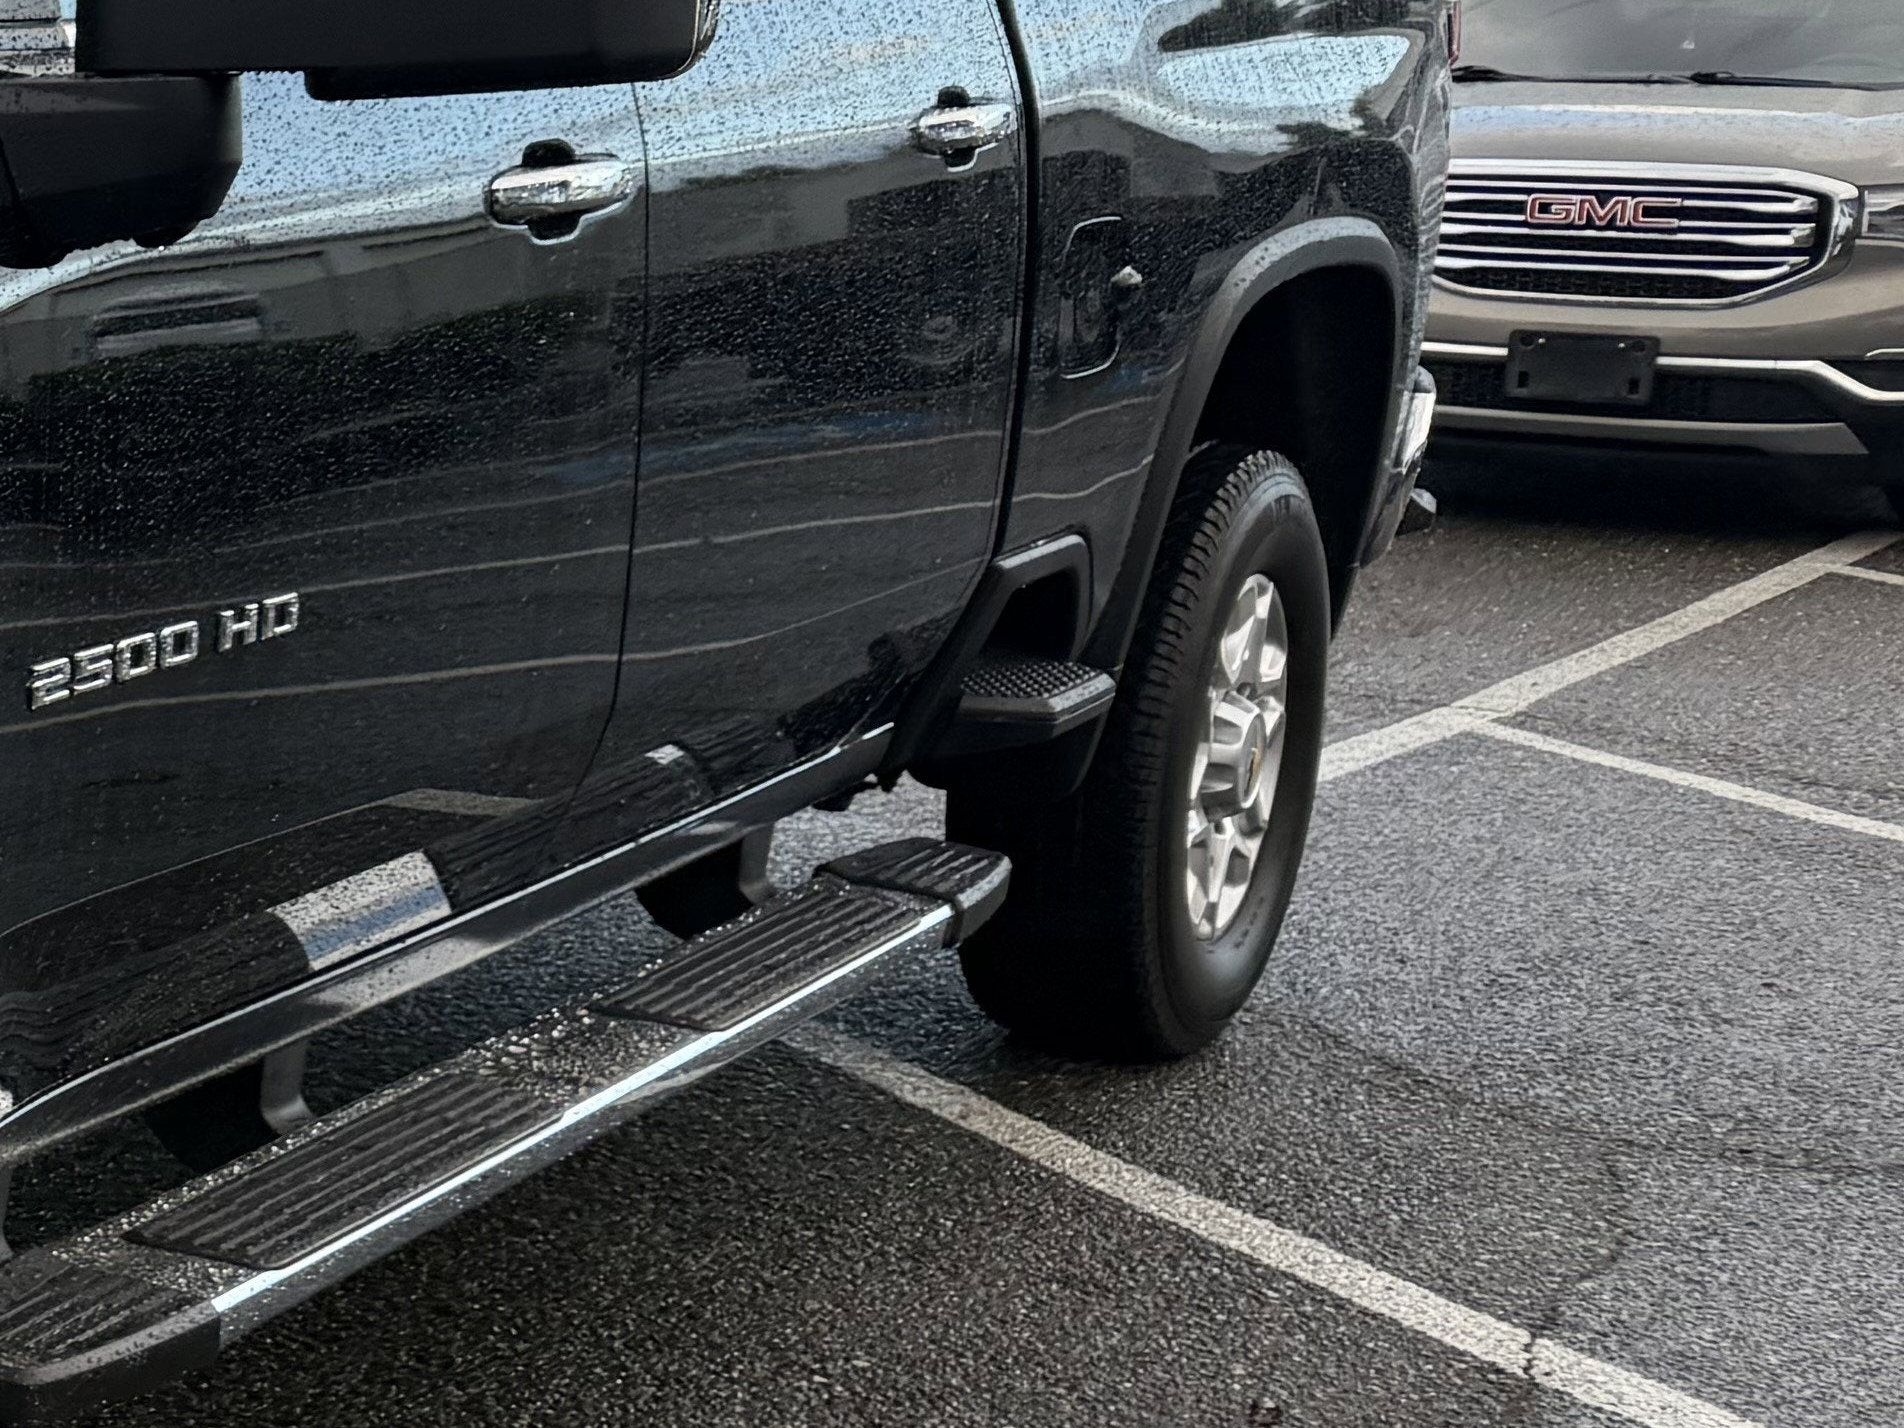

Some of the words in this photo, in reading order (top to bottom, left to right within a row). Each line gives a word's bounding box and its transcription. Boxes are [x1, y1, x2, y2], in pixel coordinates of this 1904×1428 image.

[1527, 194, 1683, 228] GMC
[30, 620, 199, 710] 2500
[218, 592, 299, 652] HD
